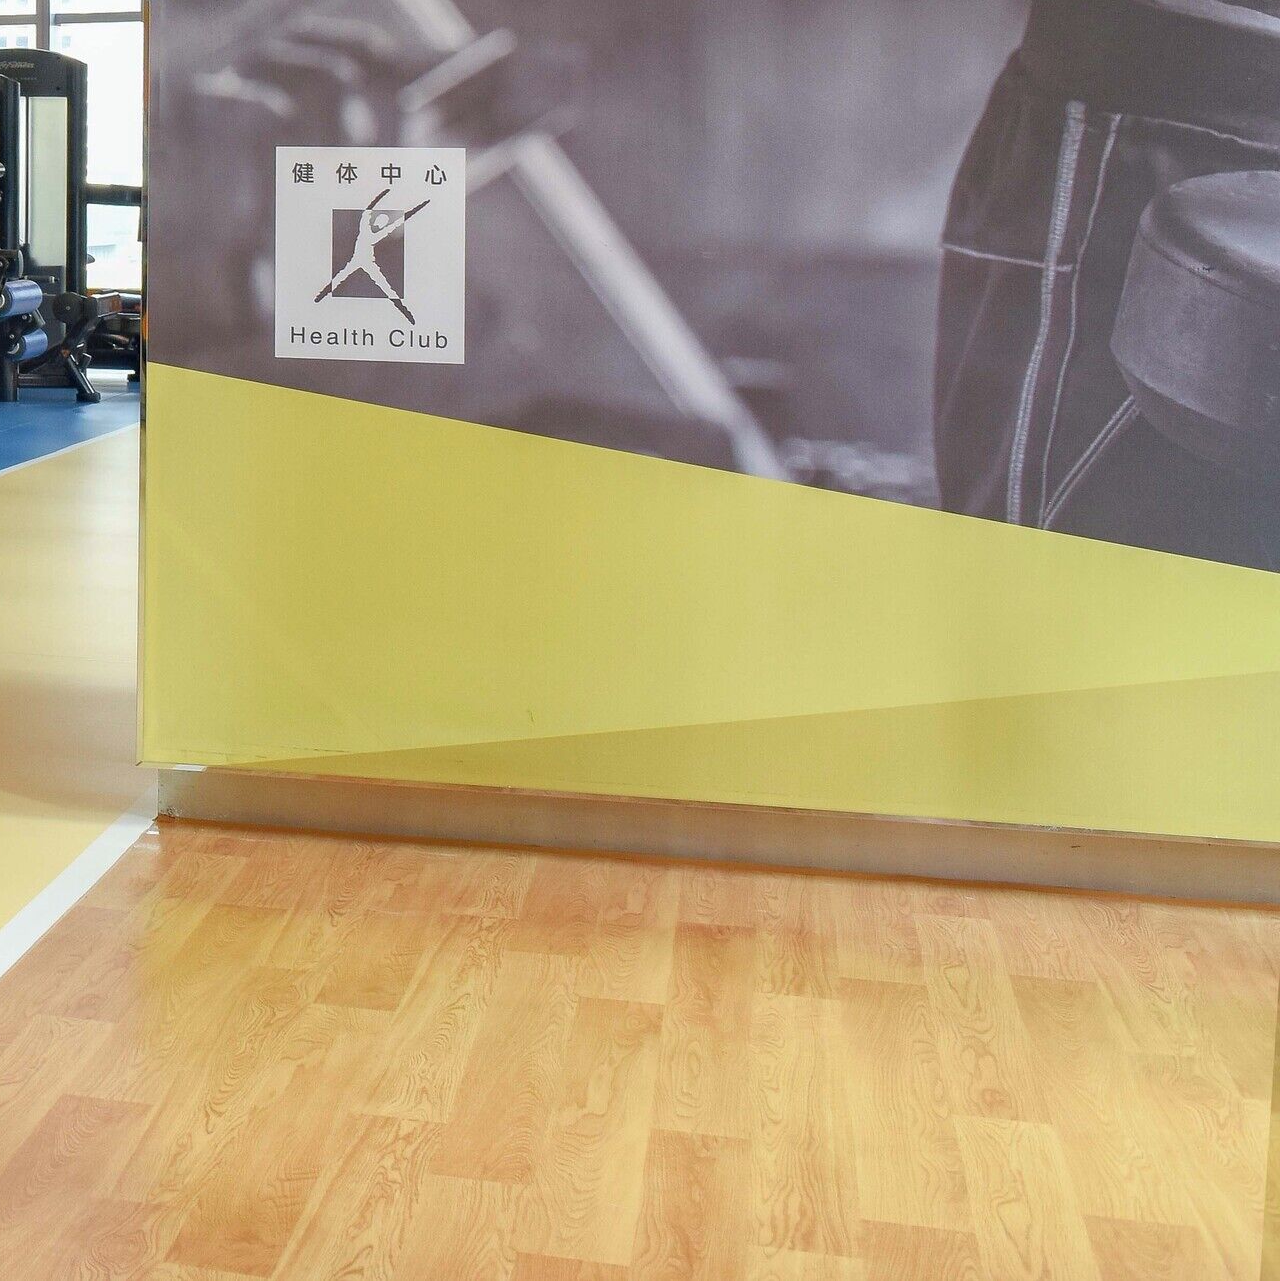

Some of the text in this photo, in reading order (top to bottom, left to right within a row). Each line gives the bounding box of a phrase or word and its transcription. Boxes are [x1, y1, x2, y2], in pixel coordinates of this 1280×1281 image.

[291, 162, 447, 186] 健体中心
[290, 326, 449, 349] Health Club
